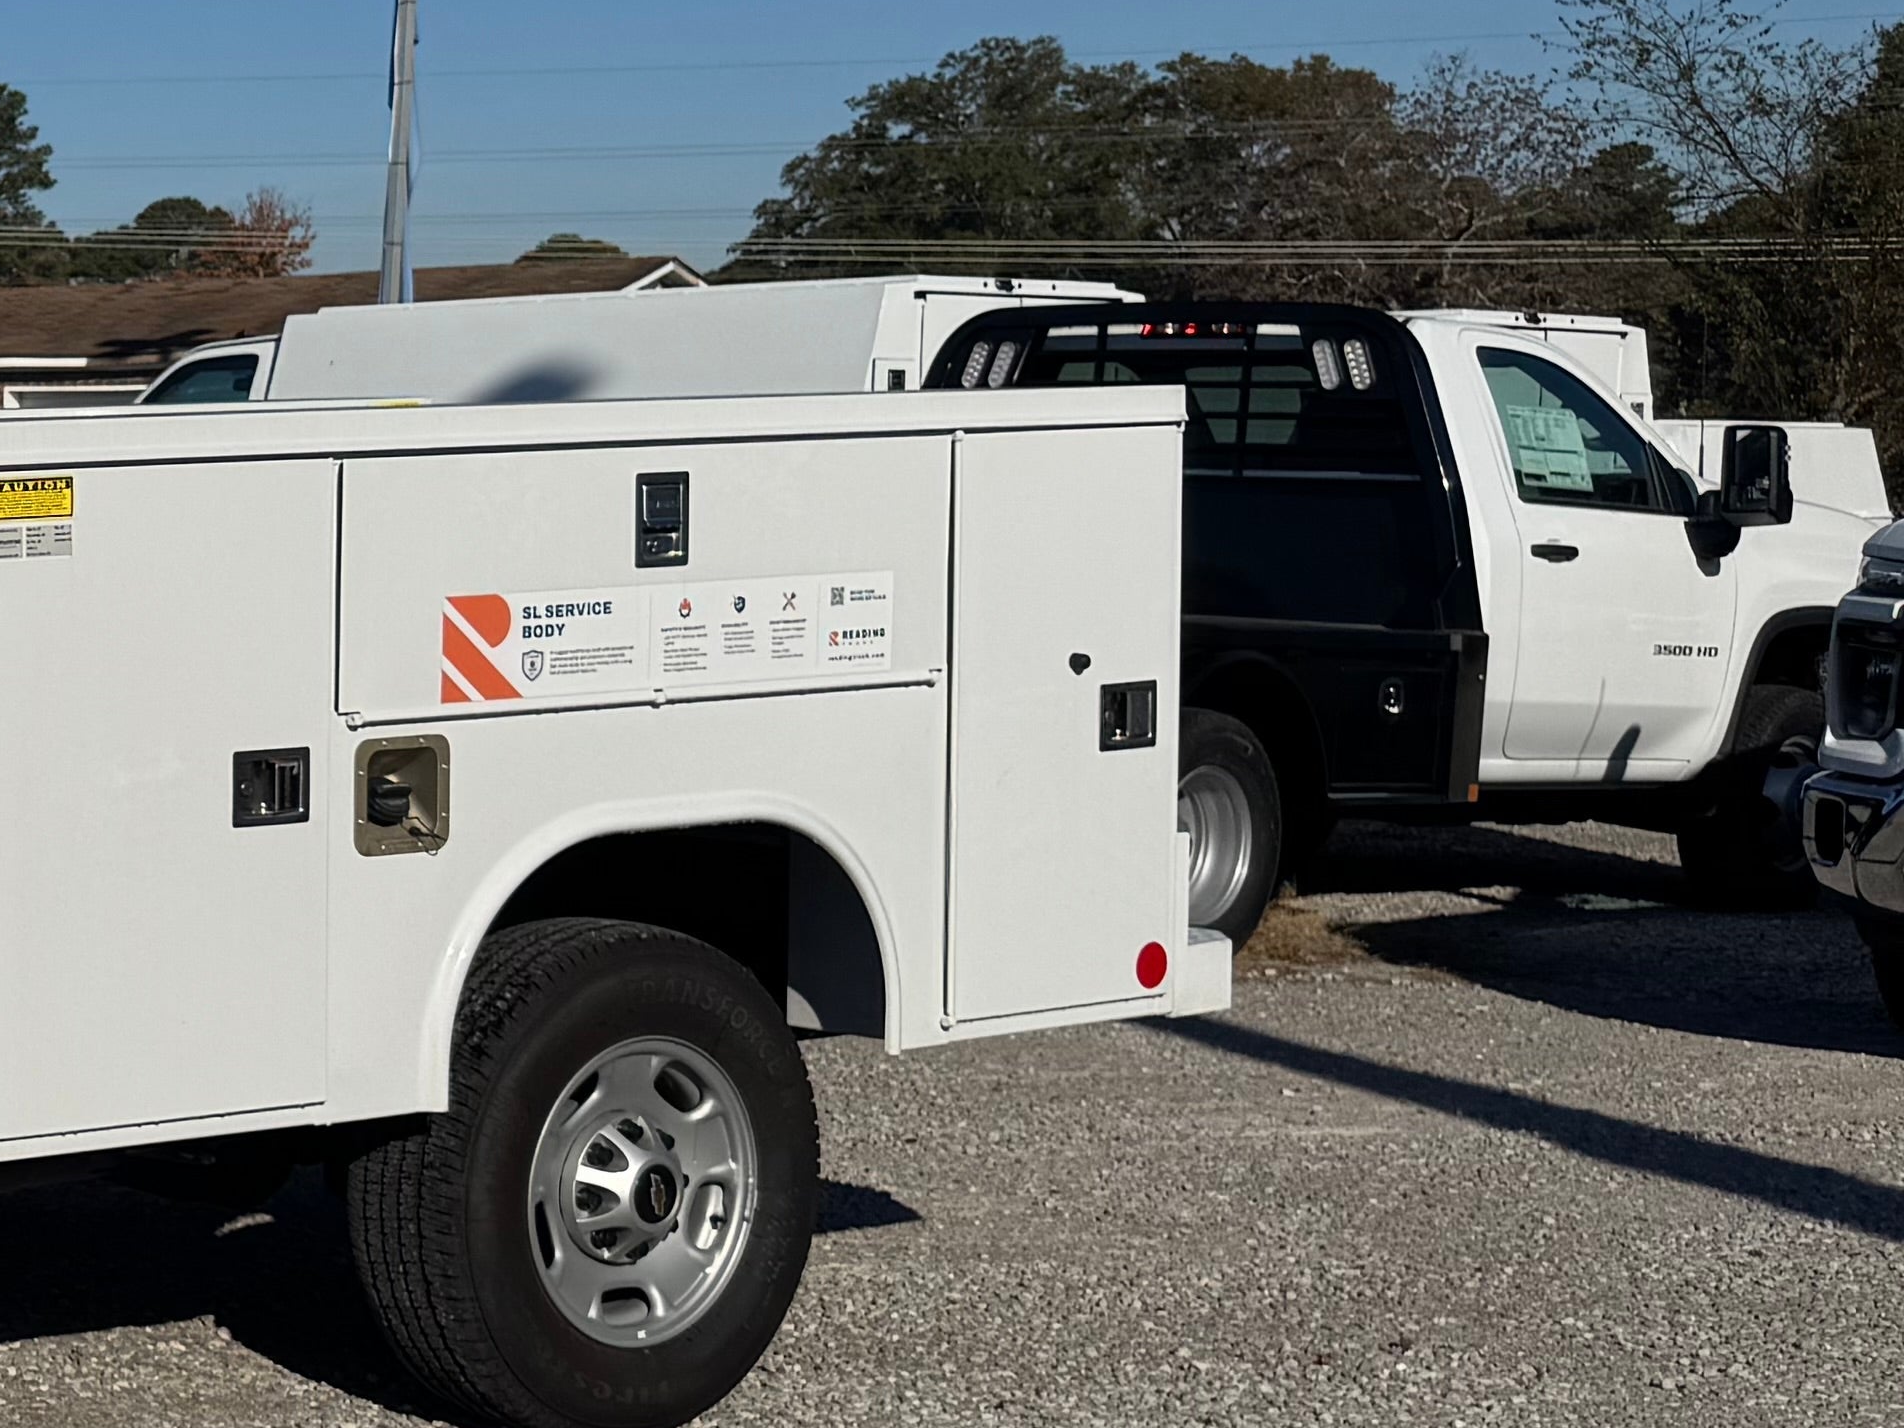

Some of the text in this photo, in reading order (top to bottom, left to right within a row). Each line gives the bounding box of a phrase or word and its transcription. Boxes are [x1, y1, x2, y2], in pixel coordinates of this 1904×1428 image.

[522, 601, 613, 619] SL SERVICE
[522, 623, 565, 639] BODY
[1697, 646, 1718, 658] HD
